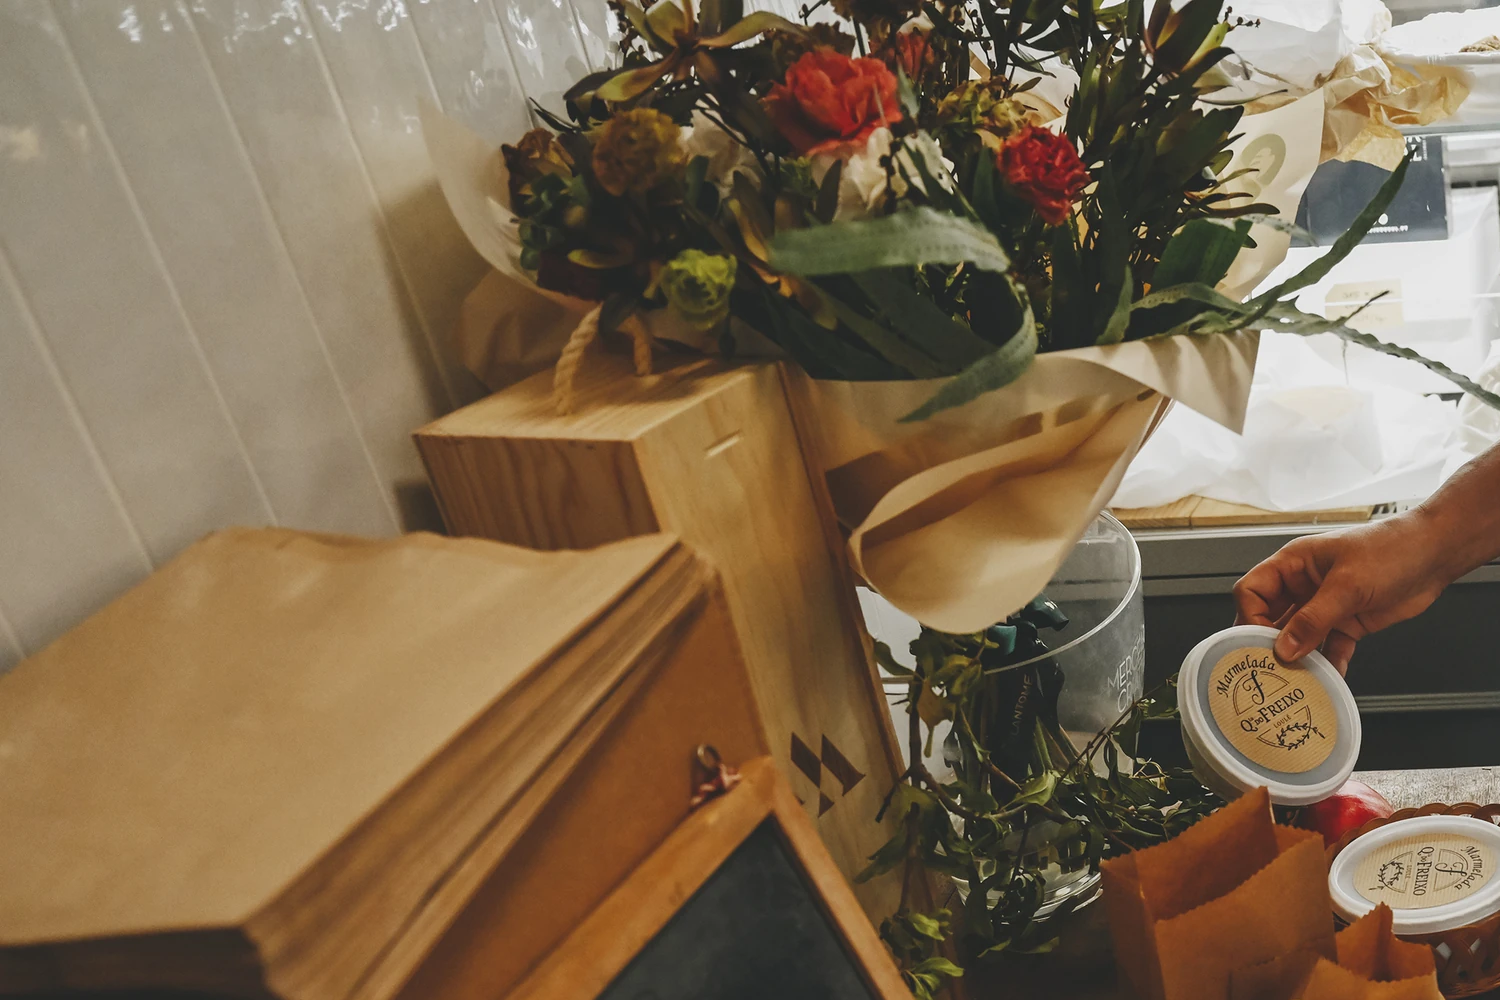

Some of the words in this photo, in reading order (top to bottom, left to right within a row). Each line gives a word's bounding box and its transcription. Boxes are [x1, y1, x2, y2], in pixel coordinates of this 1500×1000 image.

[1216, 654, 1276, 698] Marmelada
[1257, 688, 1305, 723] FREIXO
[1412, 861, 1433, 897] FREIXO
[1460, 845, 1484, 891] Marmelada
